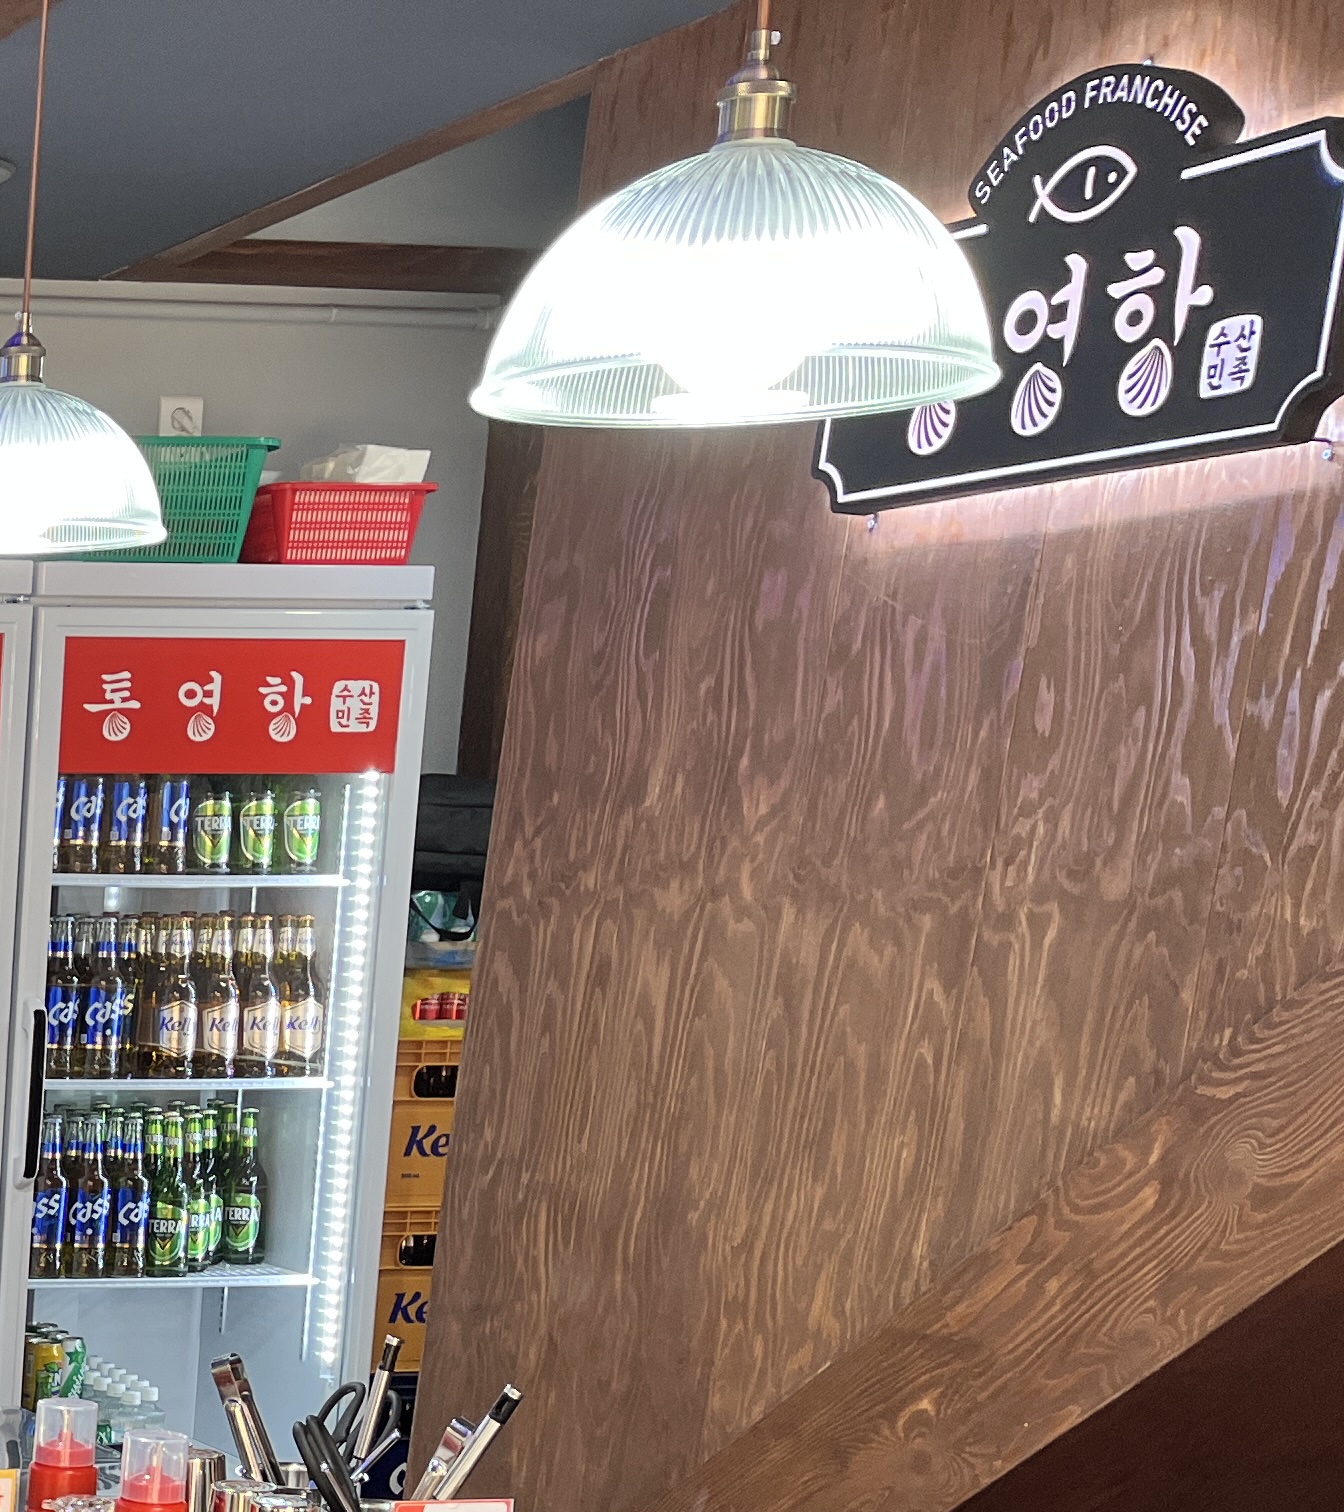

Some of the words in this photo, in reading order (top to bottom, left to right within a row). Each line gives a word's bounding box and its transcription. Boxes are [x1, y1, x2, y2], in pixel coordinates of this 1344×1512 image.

[975, 89, 1076, 205] SEAFOOD
[1084, 74, 1209, 146] FRANCHISE
[83, 670, 312, 742] 통영항
